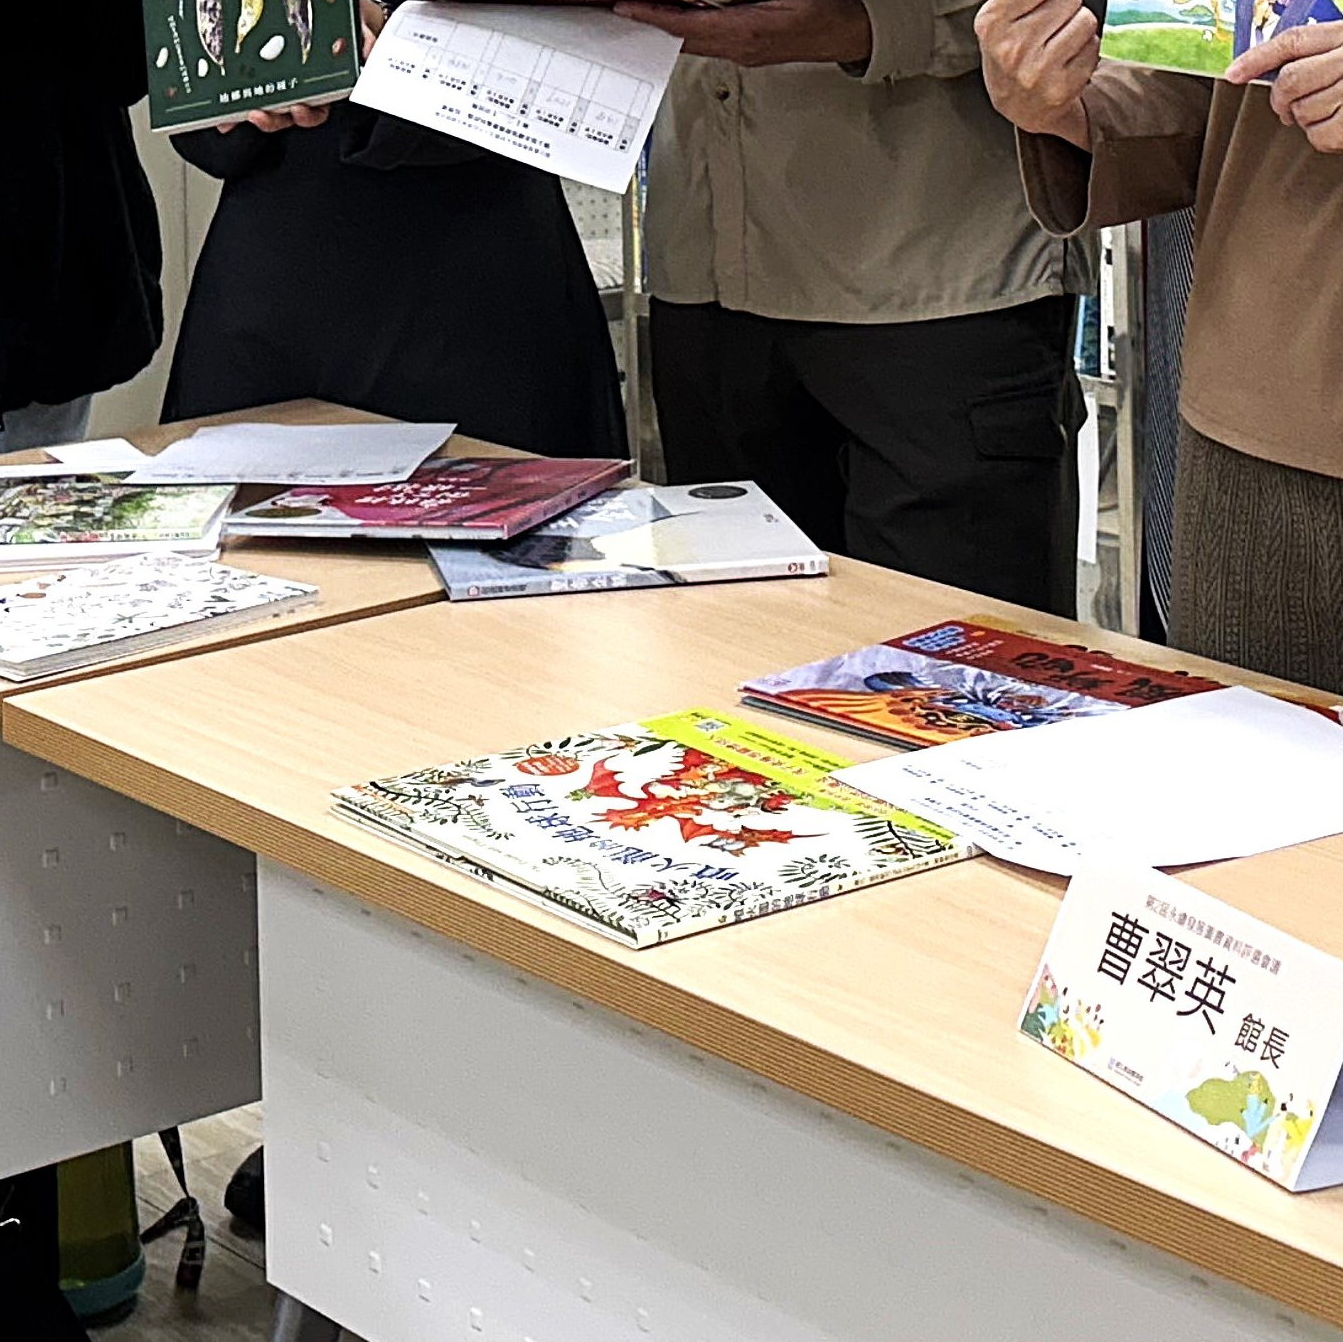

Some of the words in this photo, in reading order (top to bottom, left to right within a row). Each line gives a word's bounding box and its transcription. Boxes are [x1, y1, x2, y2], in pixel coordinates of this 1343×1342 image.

[1096, 911, 1237, 1036] 曹翠英
[1233, 1012, 1290, 1069] 館長
